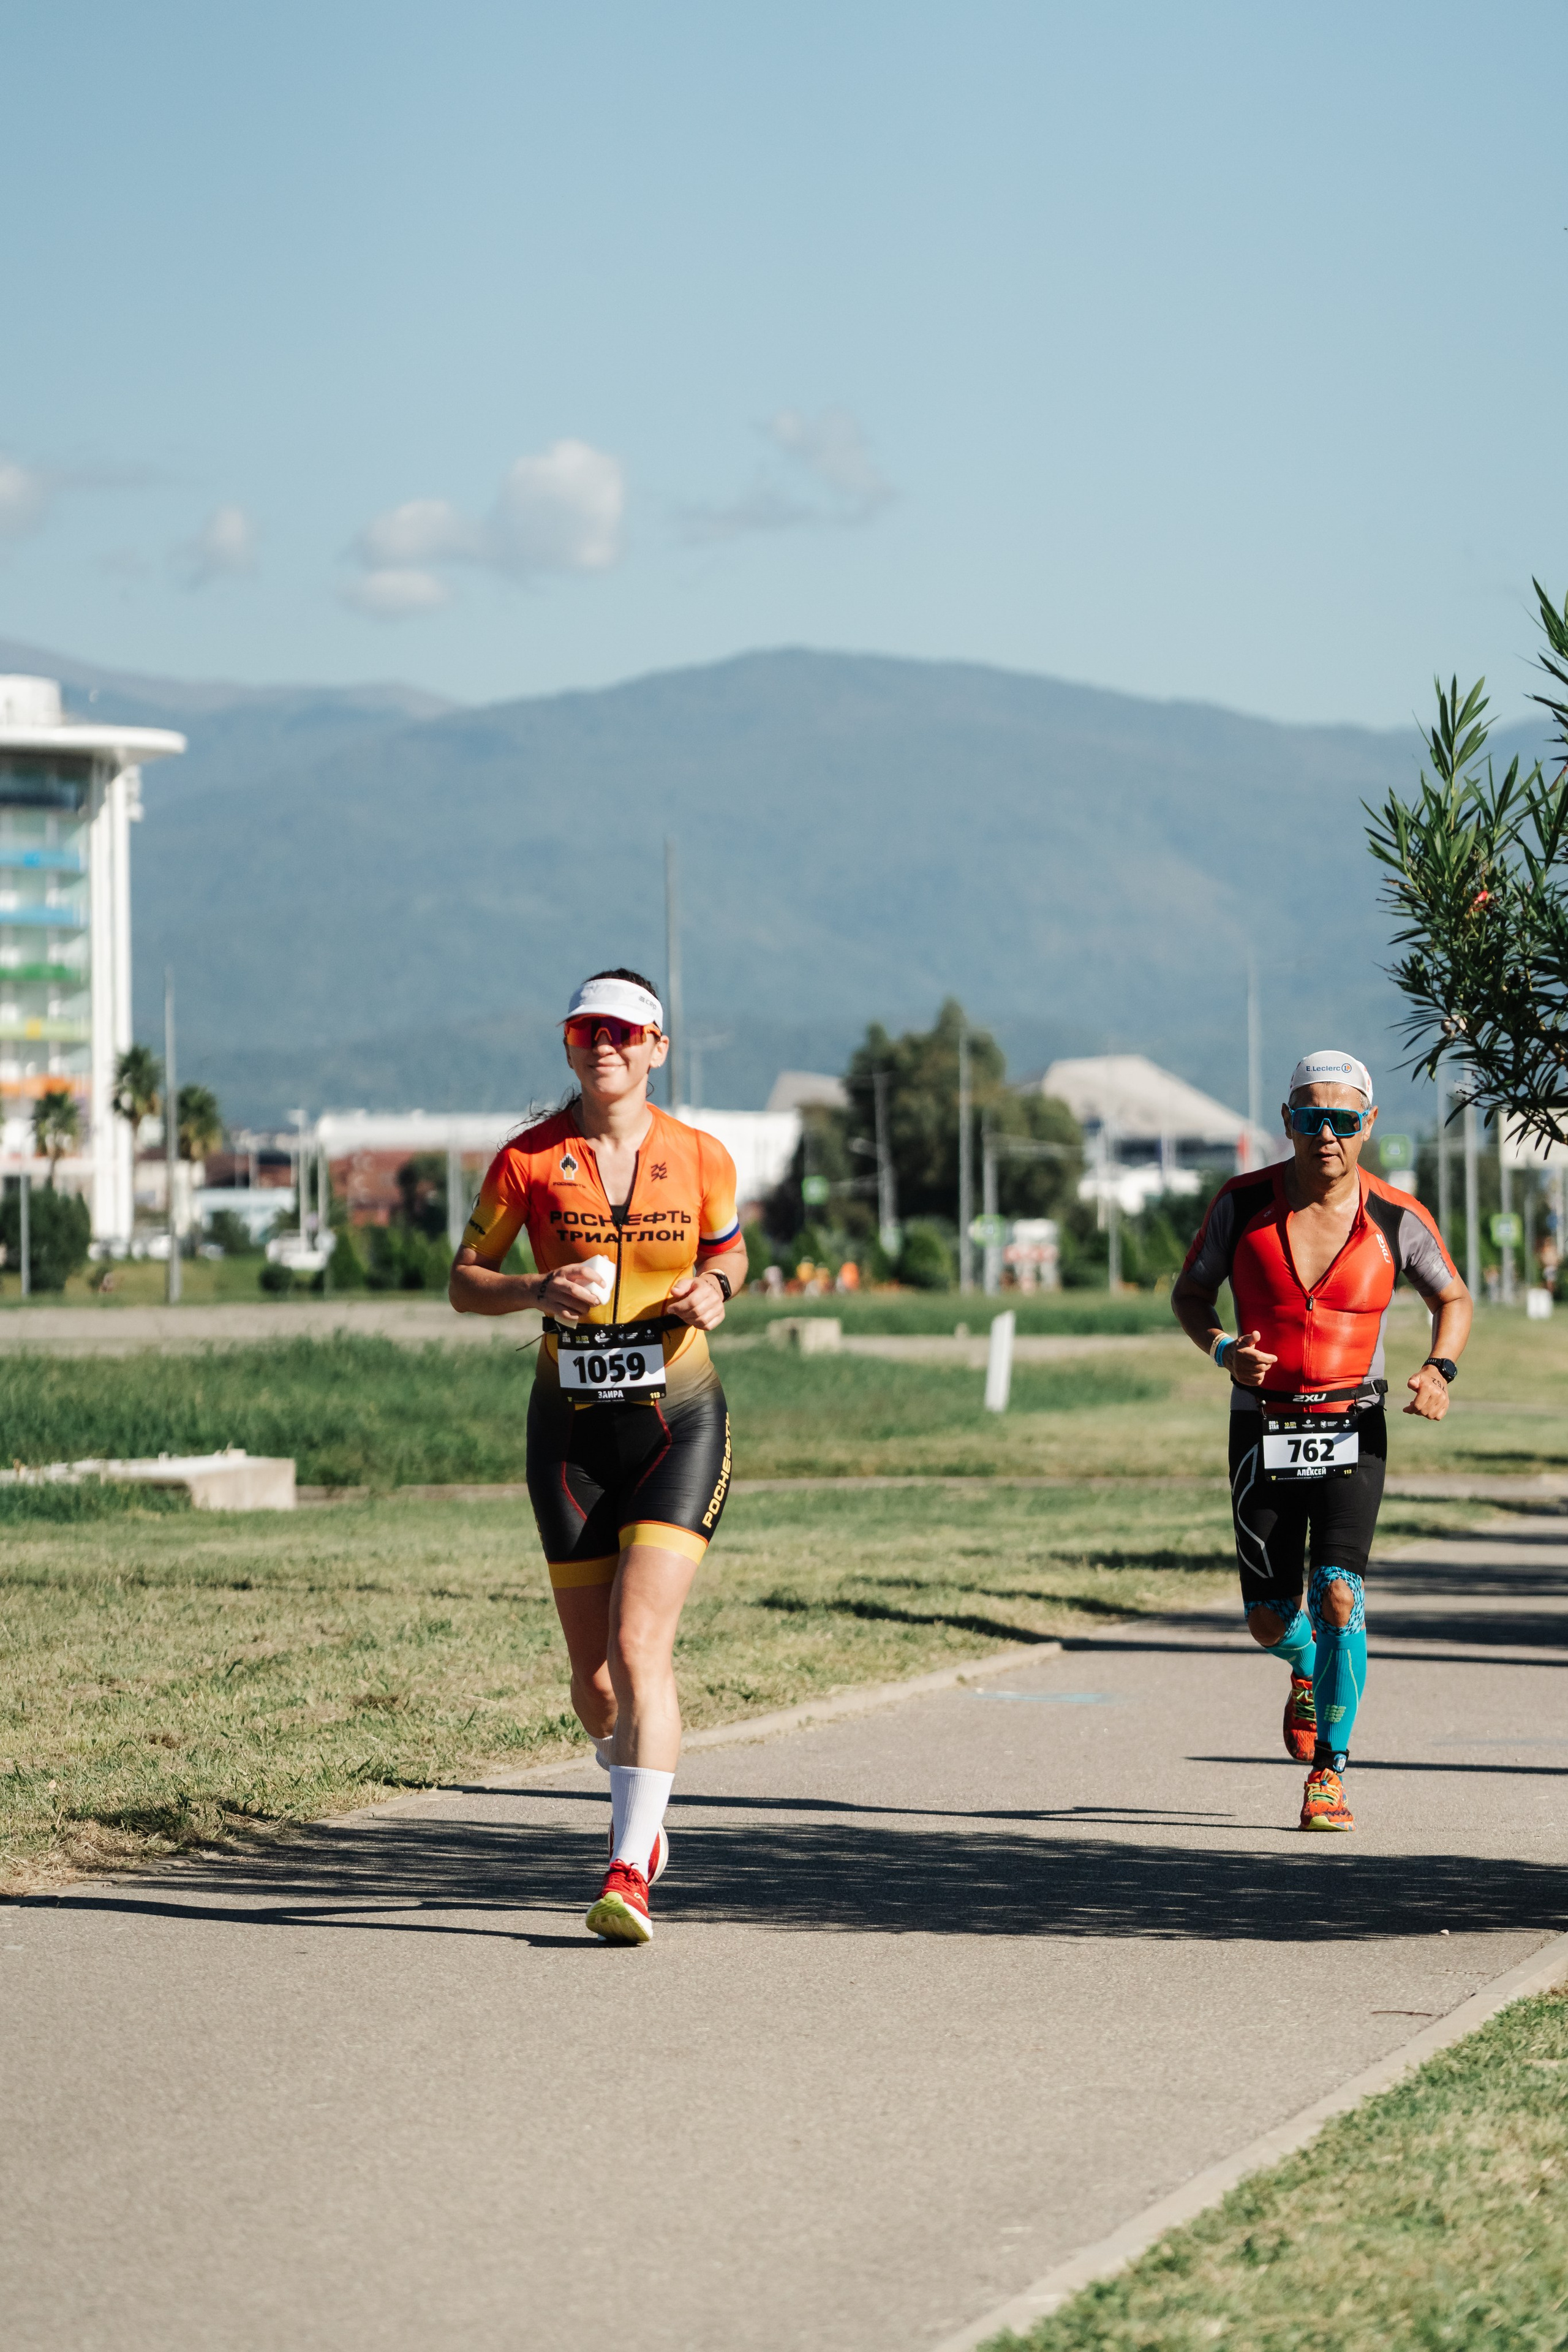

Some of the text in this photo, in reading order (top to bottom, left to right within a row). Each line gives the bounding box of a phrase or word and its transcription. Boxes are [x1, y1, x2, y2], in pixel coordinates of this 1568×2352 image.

[550, 1210, 692, 1226] РОСНЕФТЬ
[557, 1230, 684, 1243] ТРИАТЛОН
[1376, 1234, 1391, 1264] 2XU
[572, 1352, 646, 1383] 1059
[1292, 1393, 1327, 1402] 2XU
[1287, 1439, 1334, 1463] 762
[1297, 1468, 1326, 1476] АЛЕКСЕЙ
